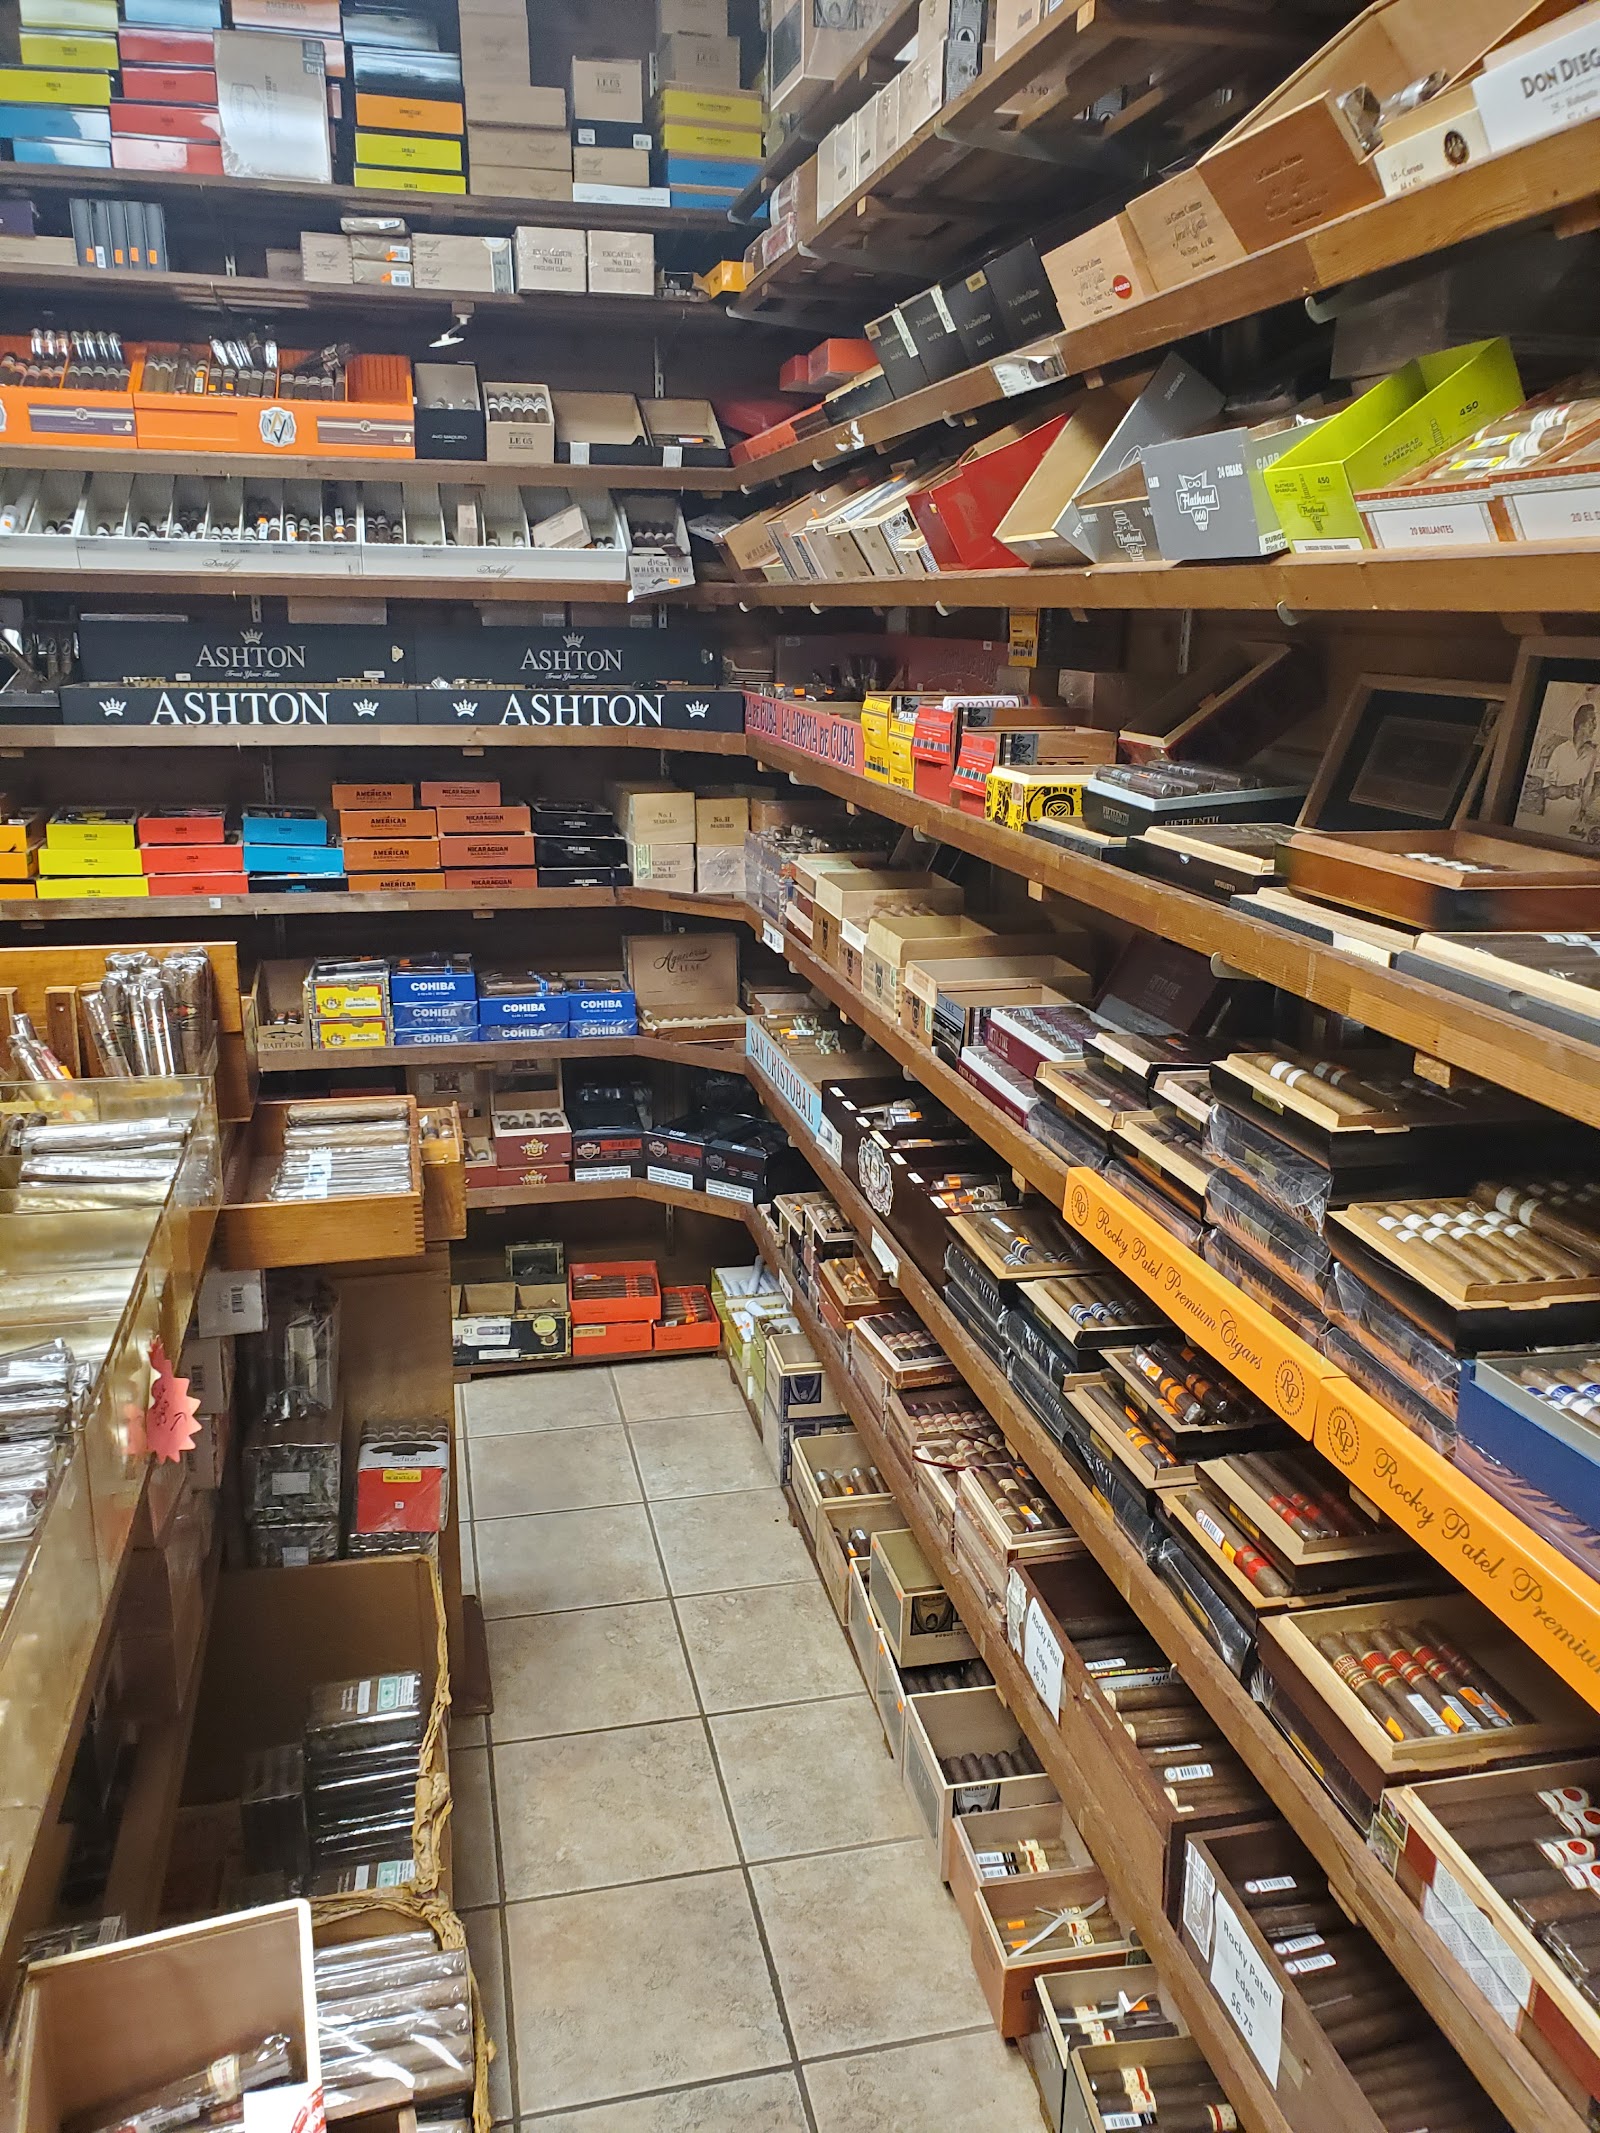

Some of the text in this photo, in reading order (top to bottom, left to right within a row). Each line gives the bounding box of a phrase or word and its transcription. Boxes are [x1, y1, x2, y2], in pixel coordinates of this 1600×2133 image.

[1520, 66, 1558, 99] DON
[1459, 401, 1479, 417] 450
[1217, 463, 1244, 480] 24 CIGARS
[1317, 476, 1330, 485] 450
[1181, 488, 1216, 507] Flathead
[1195, 510, 1207, 522] 660
[1570, 512, 1582, 523] 20
[1584, 511, 1594, 522] EL
[1410, 525, 1454, 536] 20 BRILLANTES
[647, 558, 671, 567] diesel
[196, 644, 306, 669] ASHTON
[520, 648, 623, 672] ASHTON
[243, 670, 262, 680] Your
[562, 672, 580, 682] Your
[150, 691, 331, 726] ASHTON
[499, 693, 665, 727] ASHTON
[761, 700, 778, 737] CUBA
[781, 708, 791, 745] LA
[791, 711, 819, 755] AROMA
[819, 727, 830, 759] DE
[830, 721, 856, 769] CUBA
[1214, 879, 1236, 893] ROBUSTO
[411, 981, 456, 991] COHIBA
[502, 1003, 546, 1013] COHIBA
[580, 999, 623, 1009] COHIBA
[412, 1008, 458, 1018] COHIBA
[414, 1034, 459, 1043] COHIBA
[502, 1028, 545, 1038] COHIBA
[581, 1026, 624, 1036] COHIBA
[263, 1042, 284, 1050] BAIT
[750, 1027, 814, 1126] SAN CRISTOBAL
[1096, 1206, 1263, 1371] Rocky Patel Premium Cigars
[1372, 1446, 1436, 1531] Rocky
[1440, 1507, 1507, 1580] Patel
[1031, 1611, 1060, 1669] Rocky Patel
[1035, 1646, 1048, 1674] Edge
[1033, 1665, 1047, 1695] $6.75
[1223, 1920, 1272, 2008] Rocky Patel
[1235, 1968, 1256, 2010] Edge
[1230, 1992, 1254, 2038] $6.75
